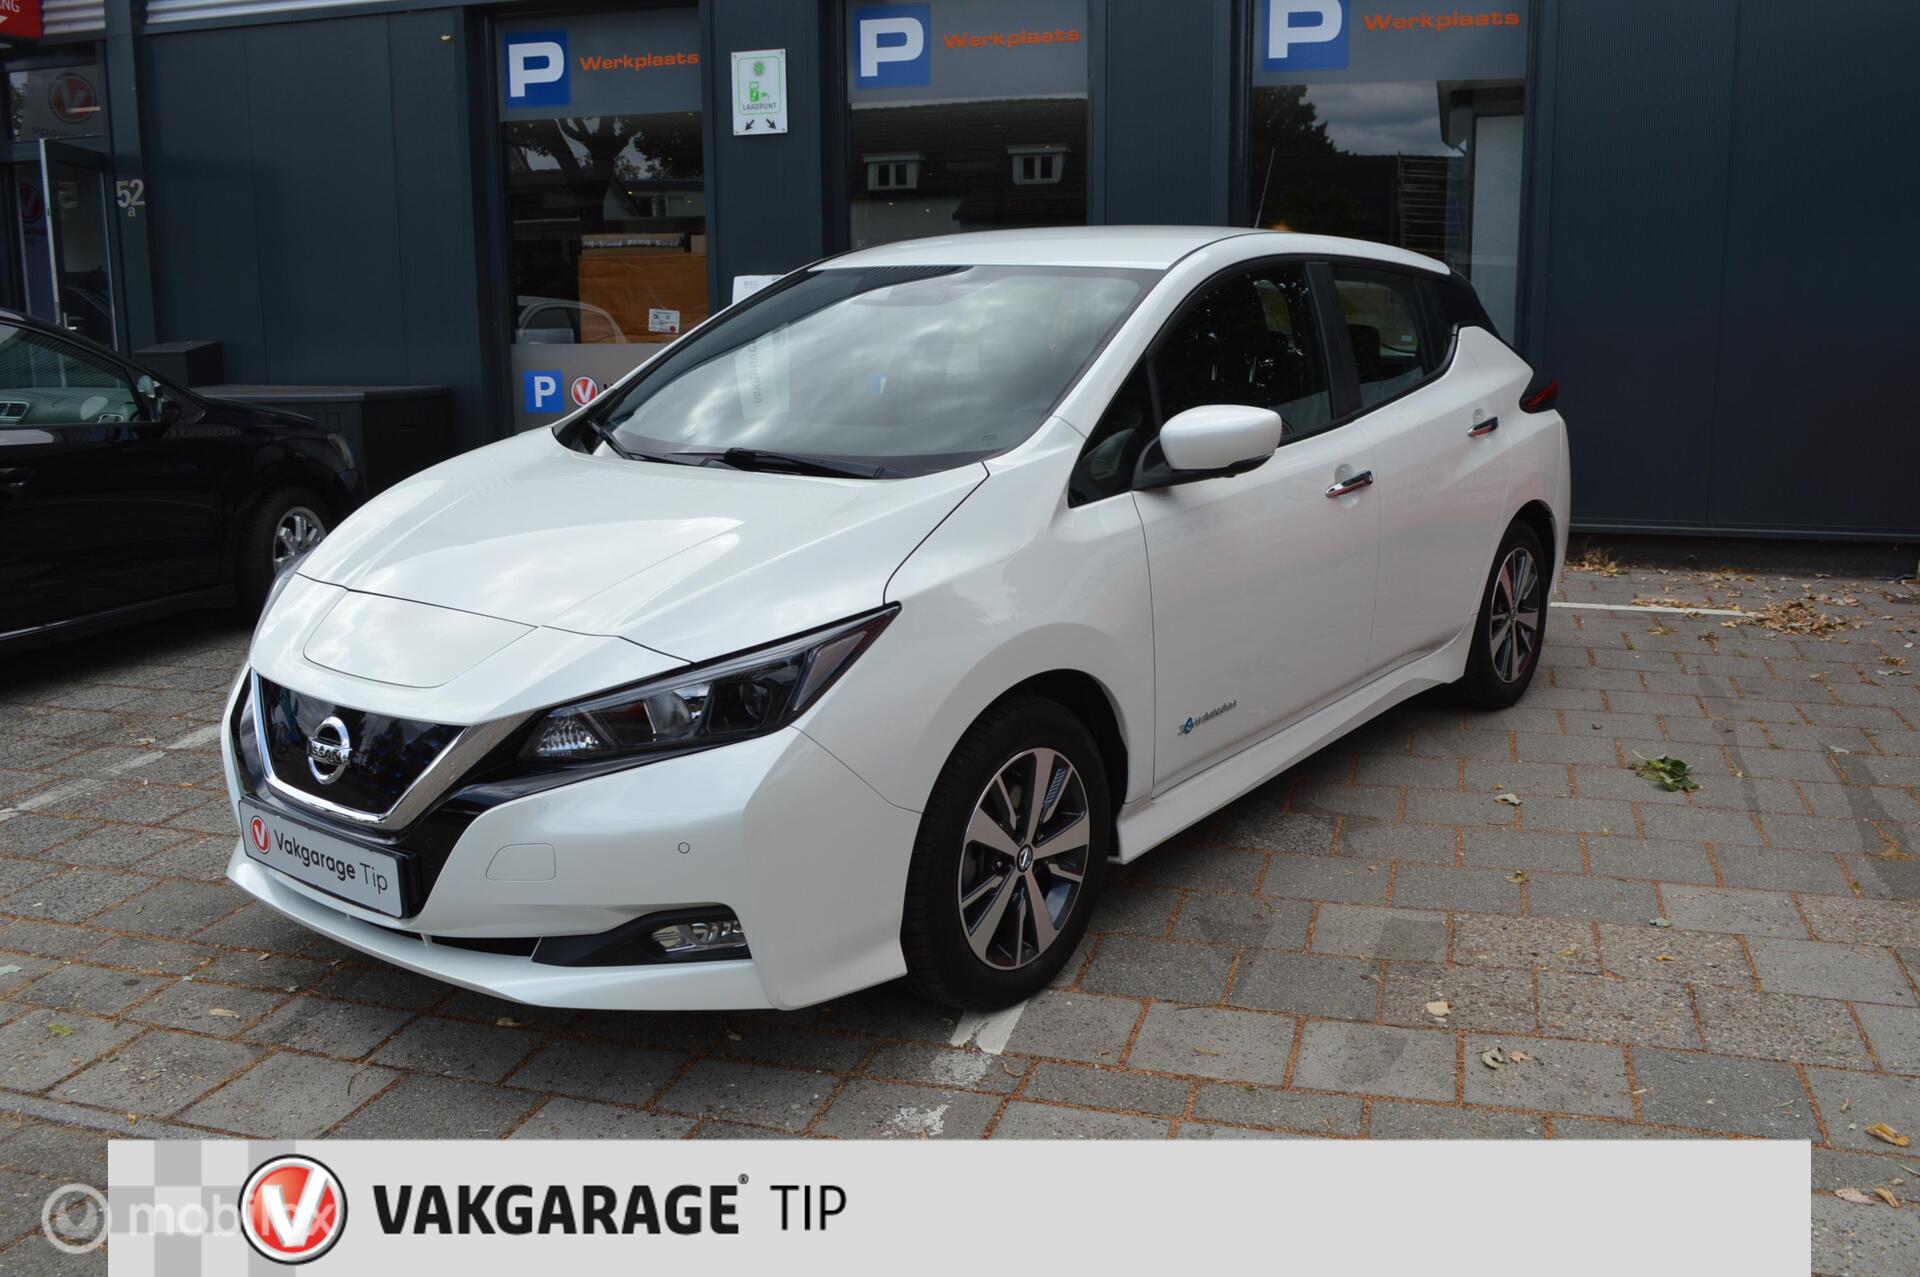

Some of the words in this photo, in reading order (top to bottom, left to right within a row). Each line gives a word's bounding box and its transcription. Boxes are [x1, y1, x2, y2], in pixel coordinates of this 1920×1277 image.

[1363, 10, 1520, 31] Werkplaats
[859, 17, 923, 75] P
[941, 28, 1081, 50] Werkplaats
[508, 41, 565, 98] P
[580, 52, 699, 71] Werkplaats
[743, 102, 777, 111] LAADPUNT
[115, 179, 146, 208] 52
[127, 205, 136, 217] a
[534, 373, 556, 408] P
[274, 829, 356, 881] Vakgarage
[359, 862, 389, 894] Tip
